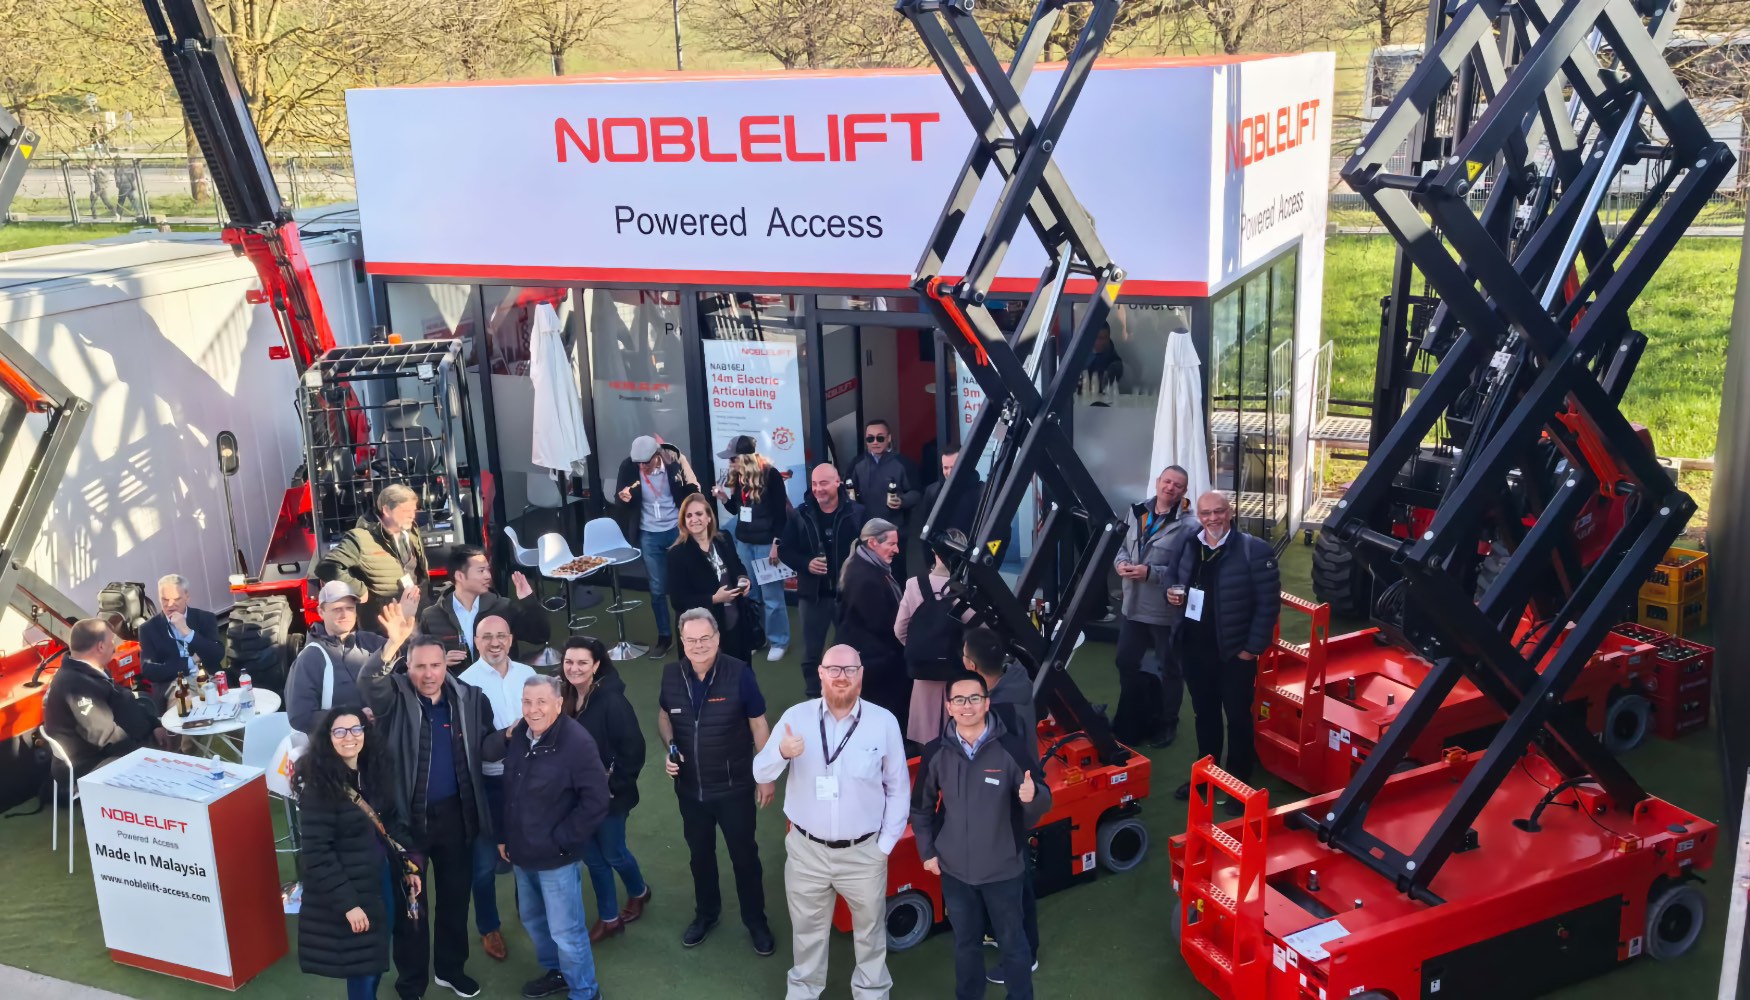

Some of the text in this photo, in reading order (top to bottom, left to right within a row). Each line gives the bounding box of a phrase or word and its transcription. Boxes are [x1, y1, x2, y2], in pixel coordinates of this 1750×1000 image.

[554, 112, 940, 163] NOBLELIFT
[1225, 98, 1320, 176] NOBLELIFT
[614, 205, 883, 239] Powered Access
[1240, 190, 1304, 240] Powered Access
[710, 362, 745, 372] NAB16EJ
[711, 373, 779, 385] 14m Electric
[712, 385, 777, 400] Articulating
[713, 397, 773, 410] Boom Lifts
[963, 387, 981, 398] 9m
[100, 806, 188, 833] NOBLELIFT
[117, 830, 179, 850] Powered Access
[95, 843, 207, 877] Made In Malaysia
[100, 873, 211, 903] www.noblelift-access.com
